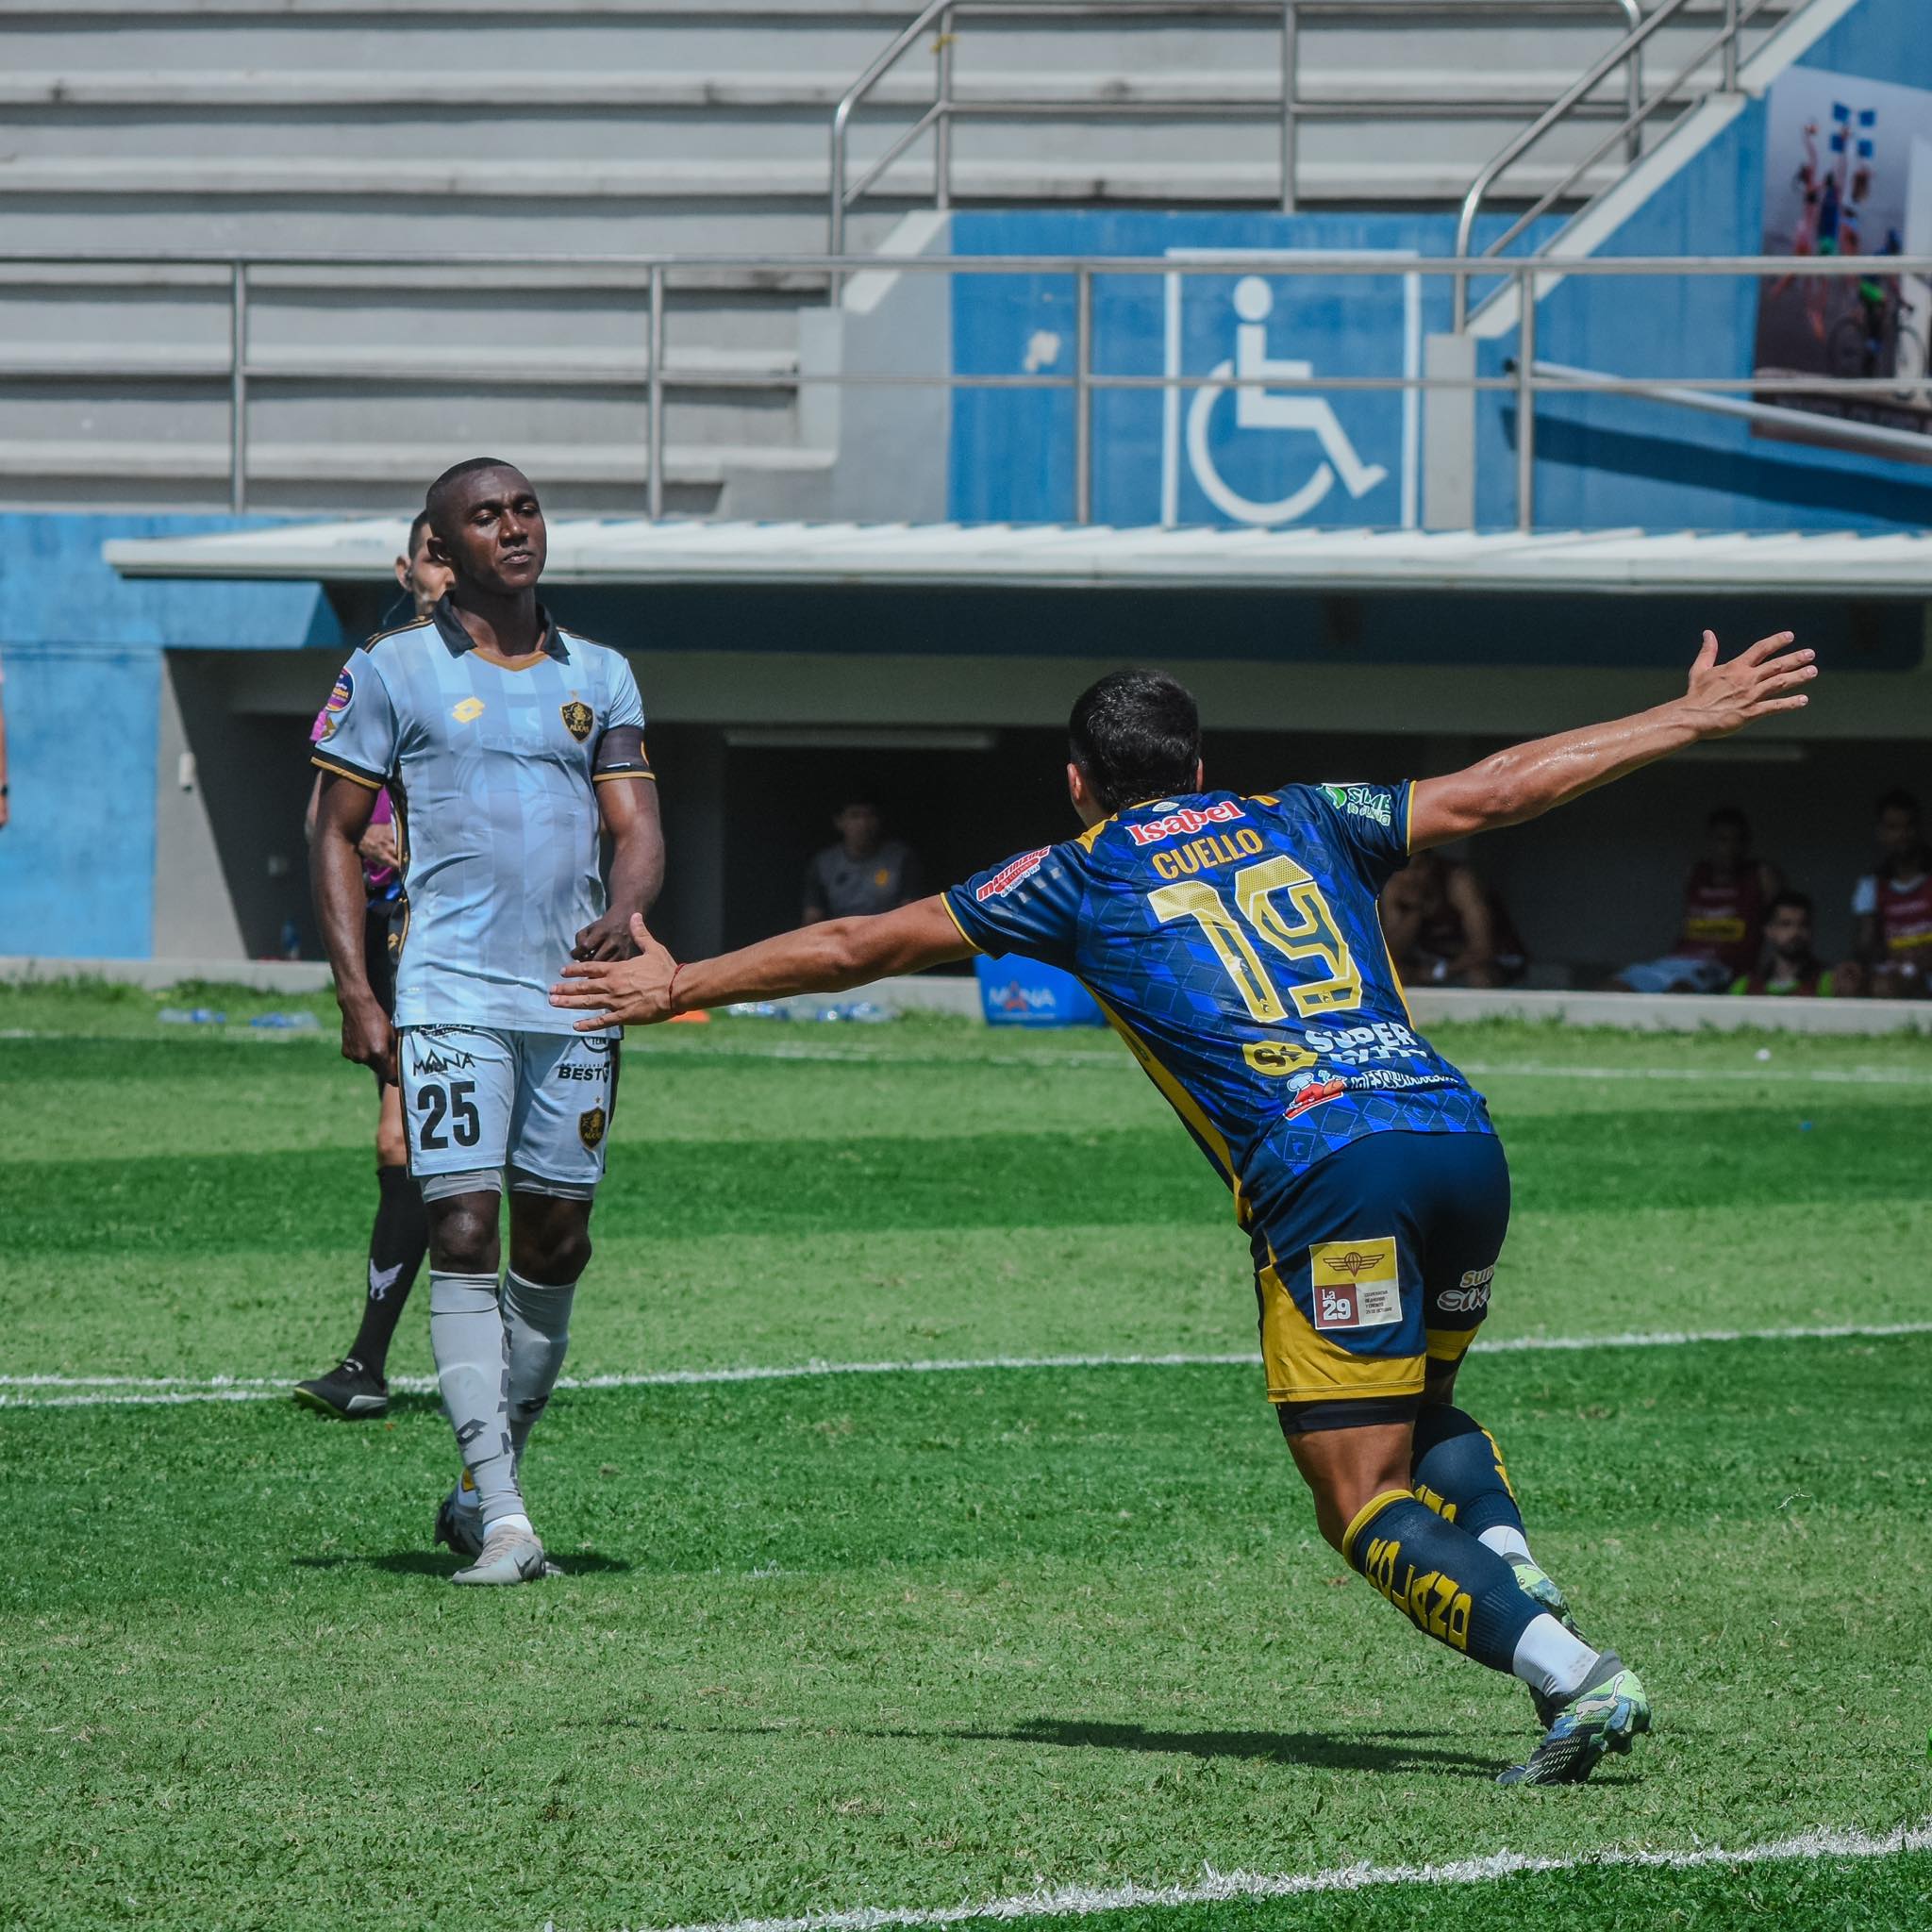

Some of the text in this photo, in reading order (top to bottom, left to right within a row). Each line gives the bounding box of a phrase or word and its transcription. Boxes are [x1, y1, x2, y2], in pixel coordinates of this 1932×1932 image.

[1124, 800, 1245, 846] Isabel
[1152, 828, 1263, 879] CUELLO
[1147, 855, 1362, 1023] 19
[1305, 1022, 1418, 1053] SUPER
[417, 1080, 480, 1151] 25
[1322, 1289, 1336, 1300] La
[1323, 1298, 1351, 1321] 29
